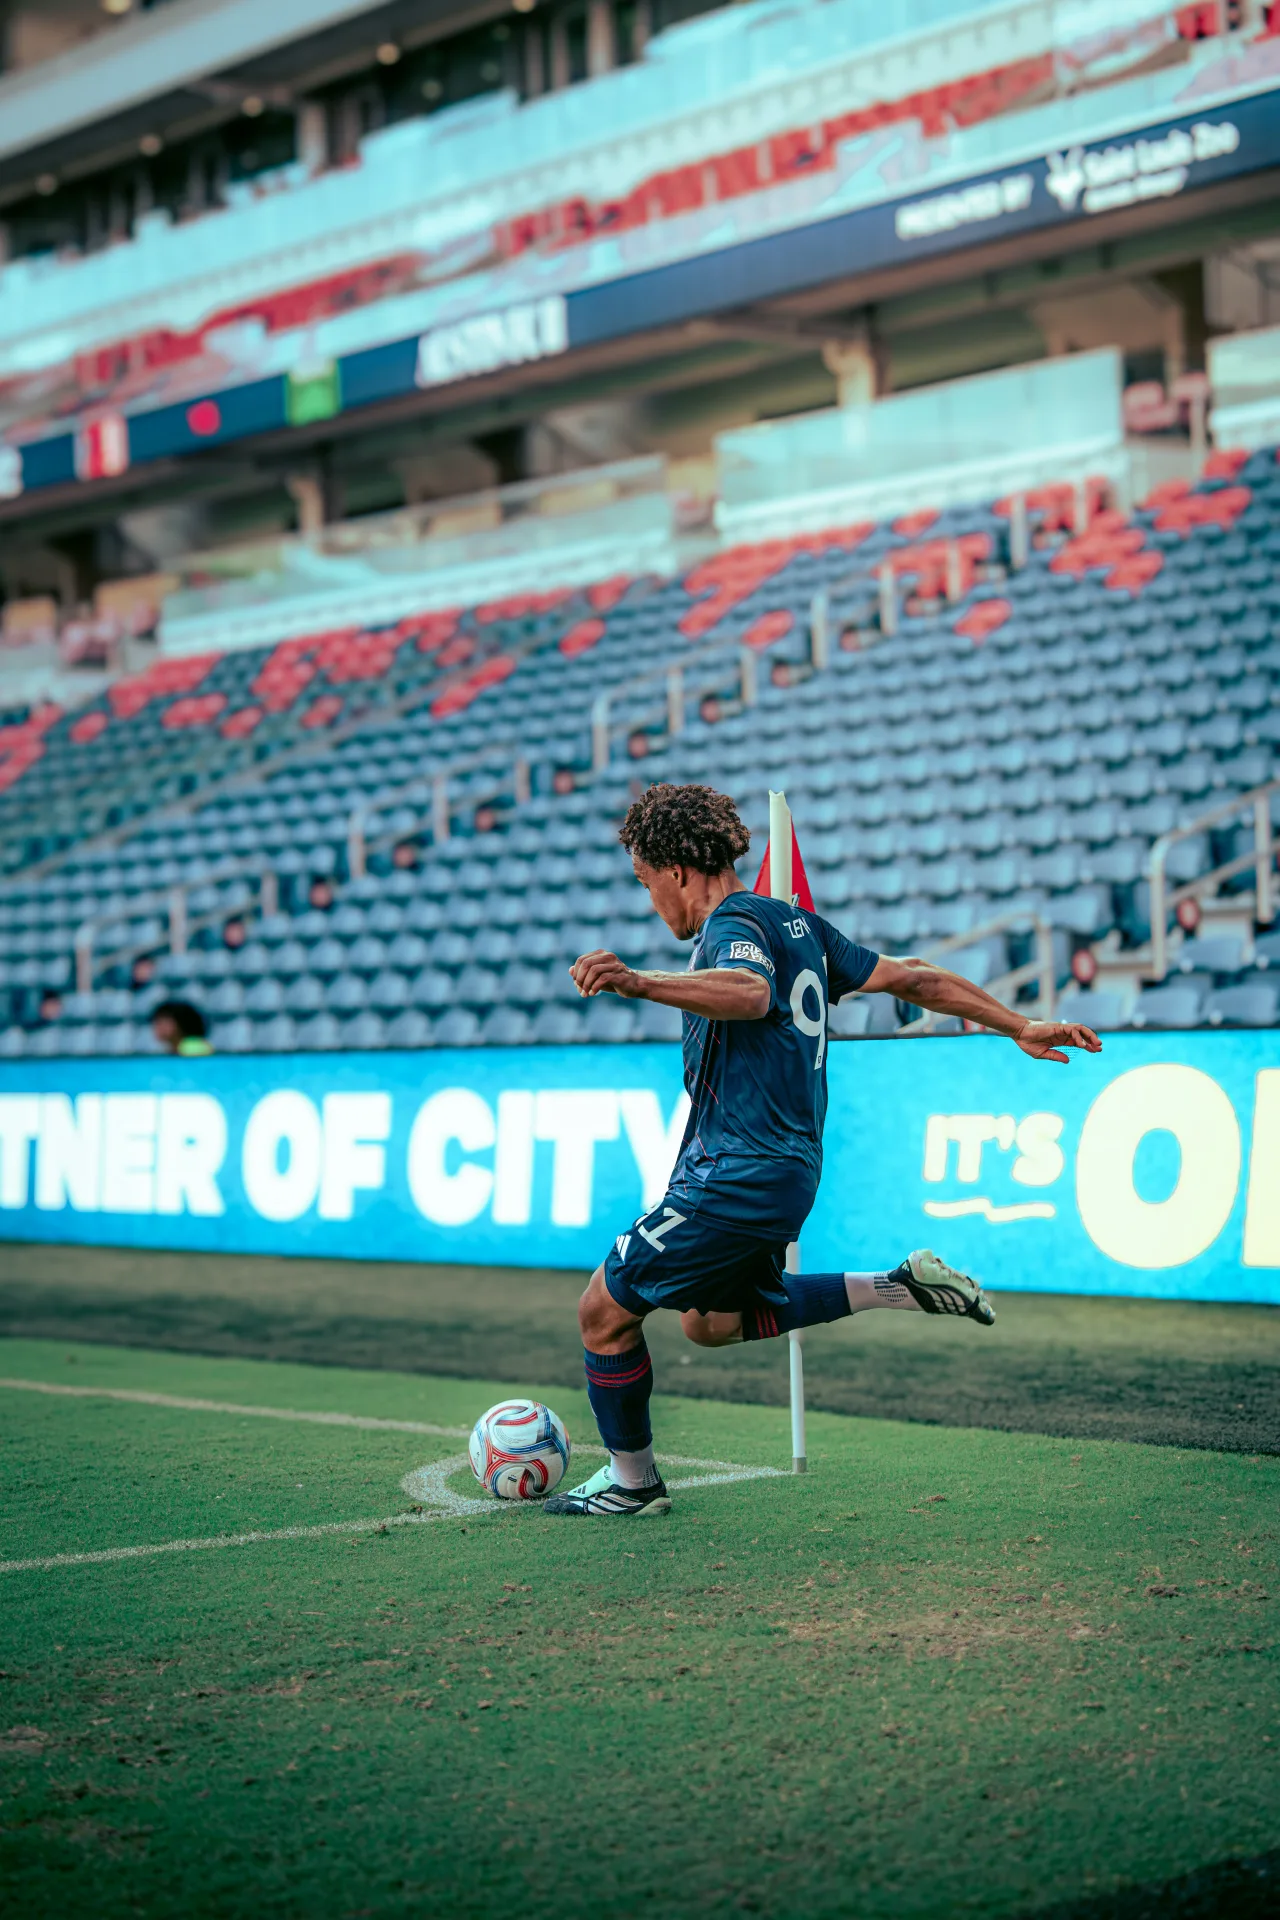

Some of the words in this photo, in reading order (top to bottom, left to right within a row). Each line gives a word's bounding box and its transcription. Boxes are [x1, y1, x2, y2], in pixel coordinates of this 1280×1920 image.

[790, 952, 828, 1070] 9
[242, 1089, 391, 1221] OF
[407, 1088, 692, 1226] CITY
[922, 1112, 1064, 1186] IT'S
